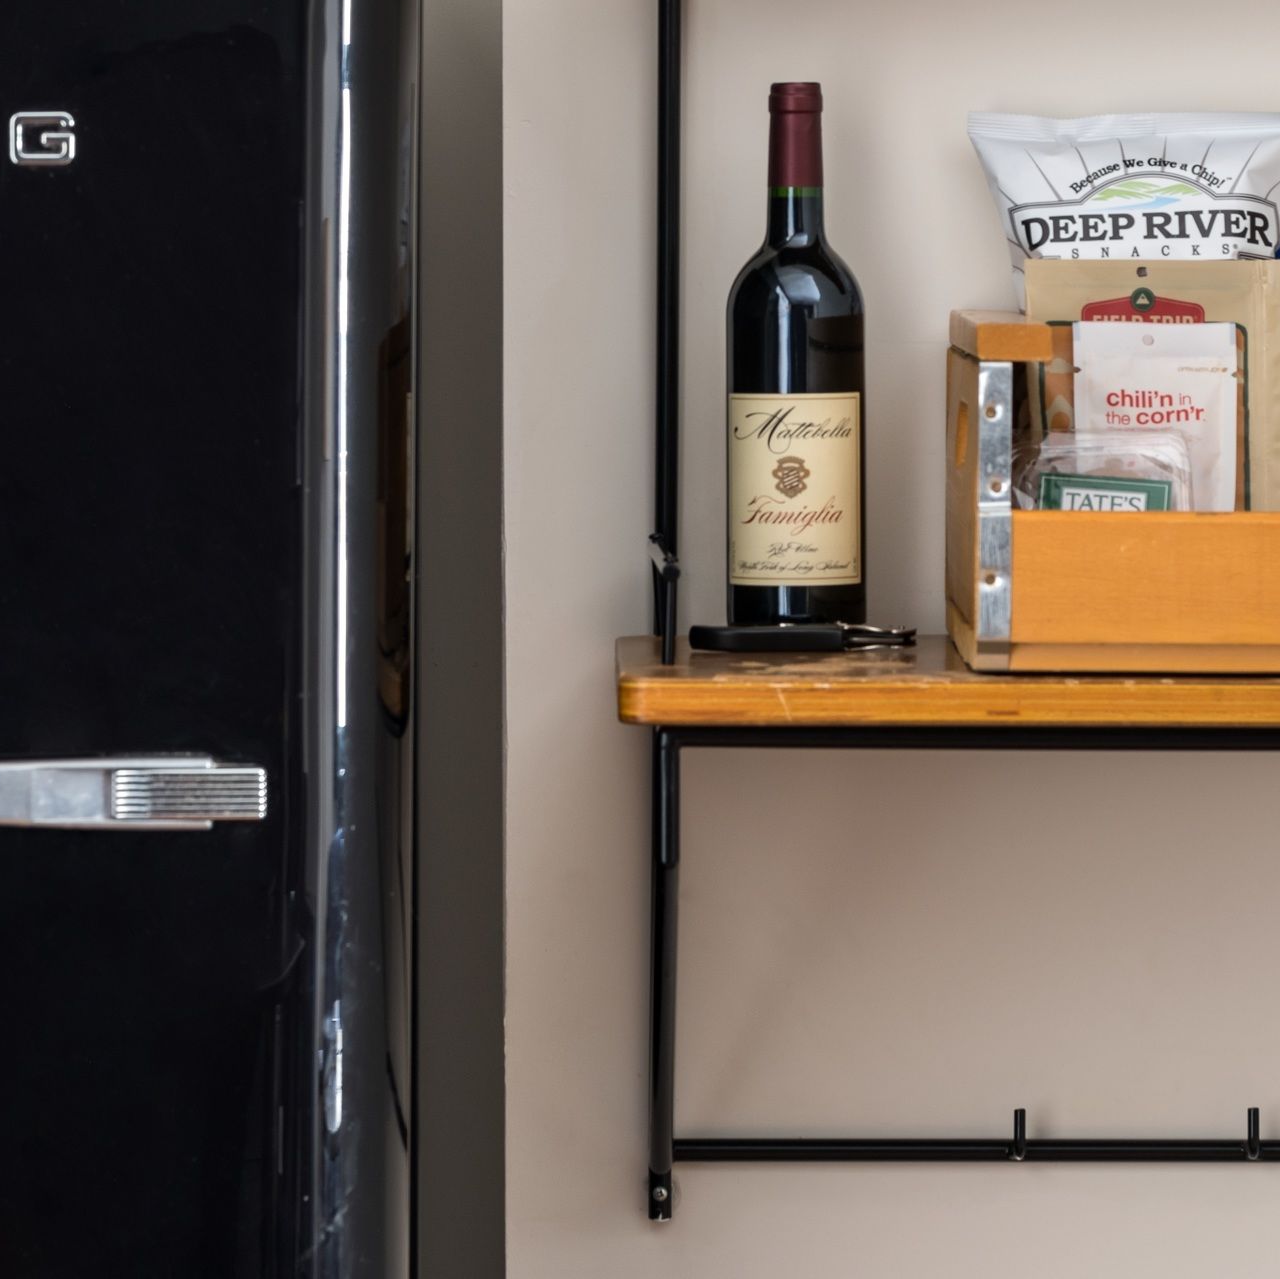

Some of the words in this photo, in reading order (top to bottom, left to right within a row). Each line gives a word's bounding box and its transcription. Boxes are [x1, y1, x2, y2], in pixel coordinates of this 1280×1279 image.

[1069, 162, 1121, 195] Because
[1122, 157, 1144, 169] We
[1147, 157, 1178, 169] Give
[1179, 163, 1188, 171] a
[1191, 164, 1227, 189] Chip!
[1021, 212, 1136, 253] DEEP
[1141, 209, 1273, 248] RIVER
[1071, 243, 1231, 260] SNACKS
[1106, 388, 1174, 409] chili'n
[1178, 392, 1192, 406] in
[1105, 410, 1131, 426] the
[1135, 406, 1205, 425] corn'r
[1065, 491, 1142, 512] TATE'S
[741, 495, 844, 536] Famiglia
